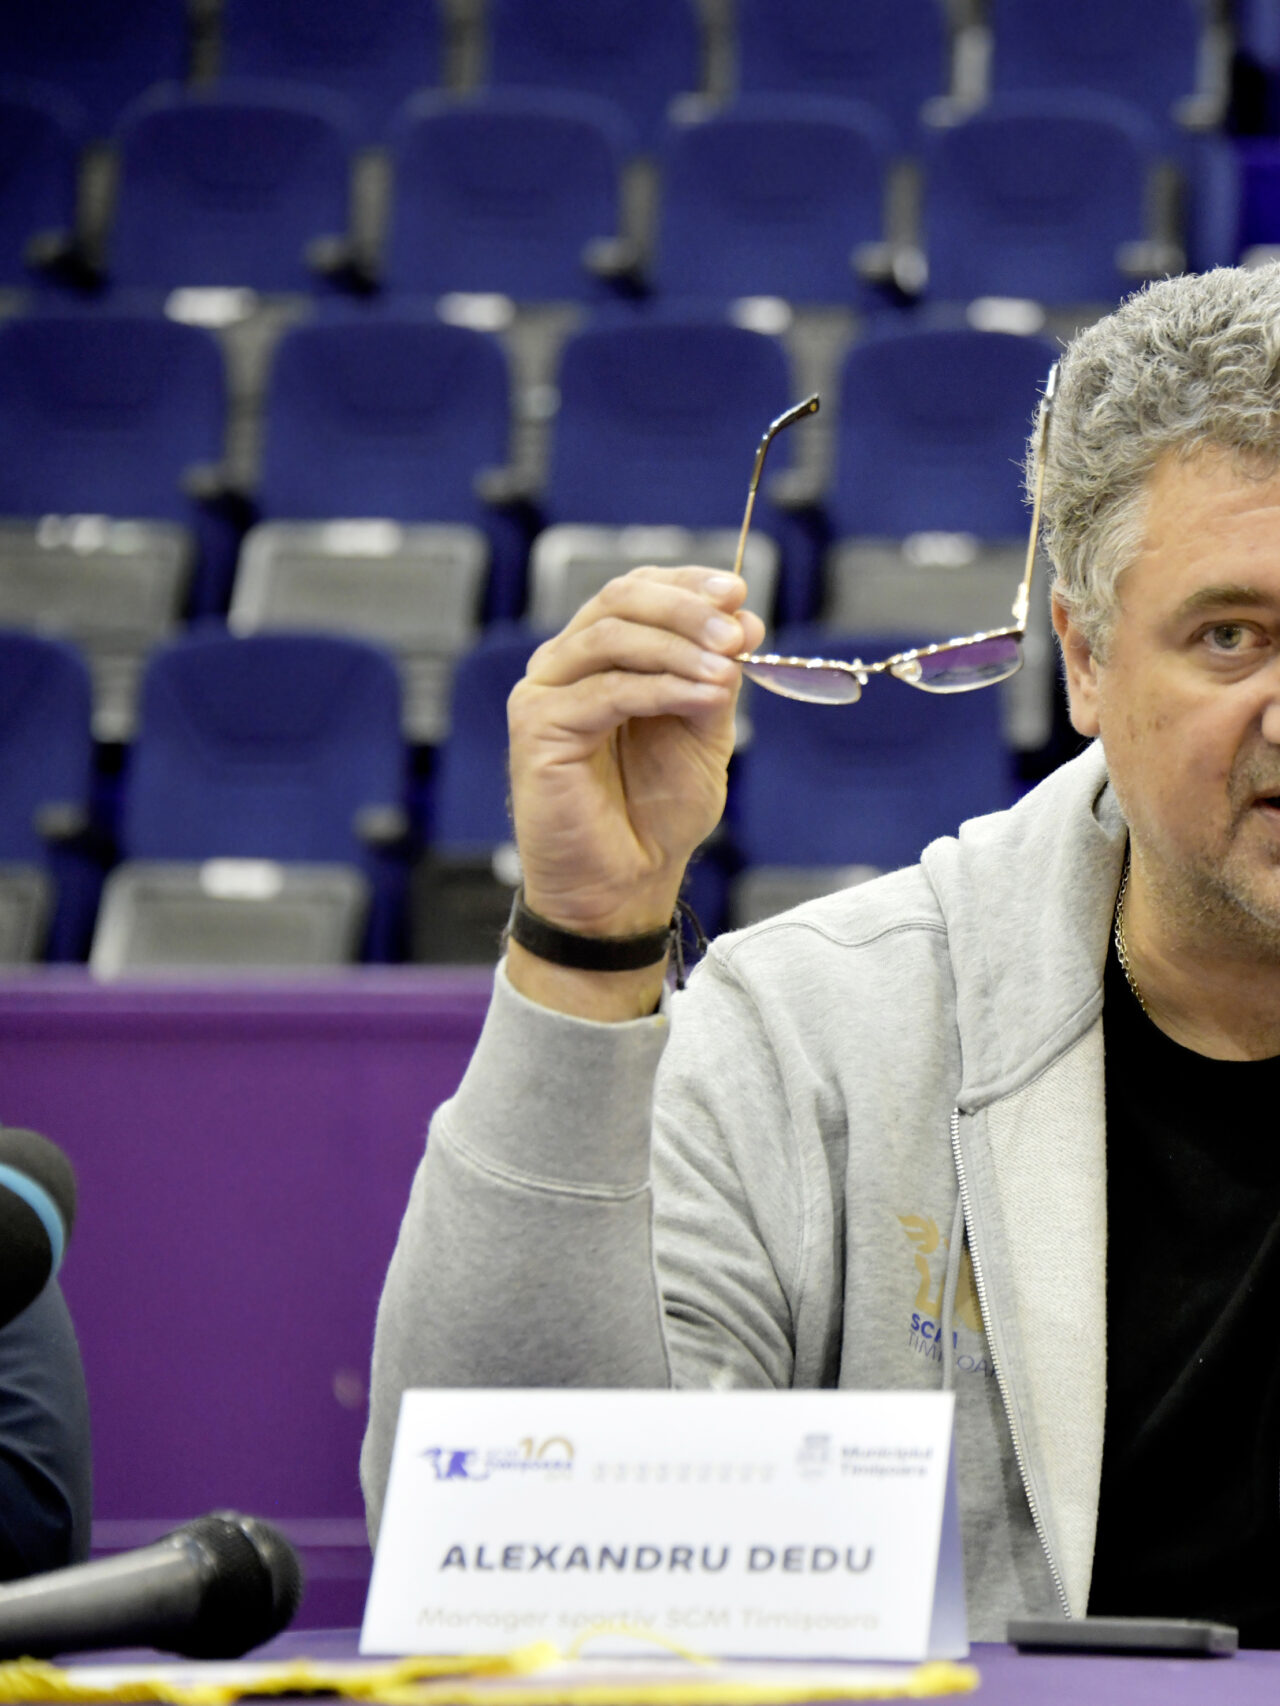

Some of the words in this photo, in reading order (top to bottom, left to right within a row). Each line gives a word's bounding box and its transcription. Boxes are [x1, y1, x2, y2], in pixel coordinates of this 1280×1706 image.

[908, 1330, 996, 1378] TIMIOA
[439, 1543, 729, 1574] ALEXANDRU
[747, 1544, 876, 1574] DEDU
[416, 1606, 550, 1635] Manager
[557, 1606, 656, 1634] sportiv
[665, 1606, 732, 1630] SCM
